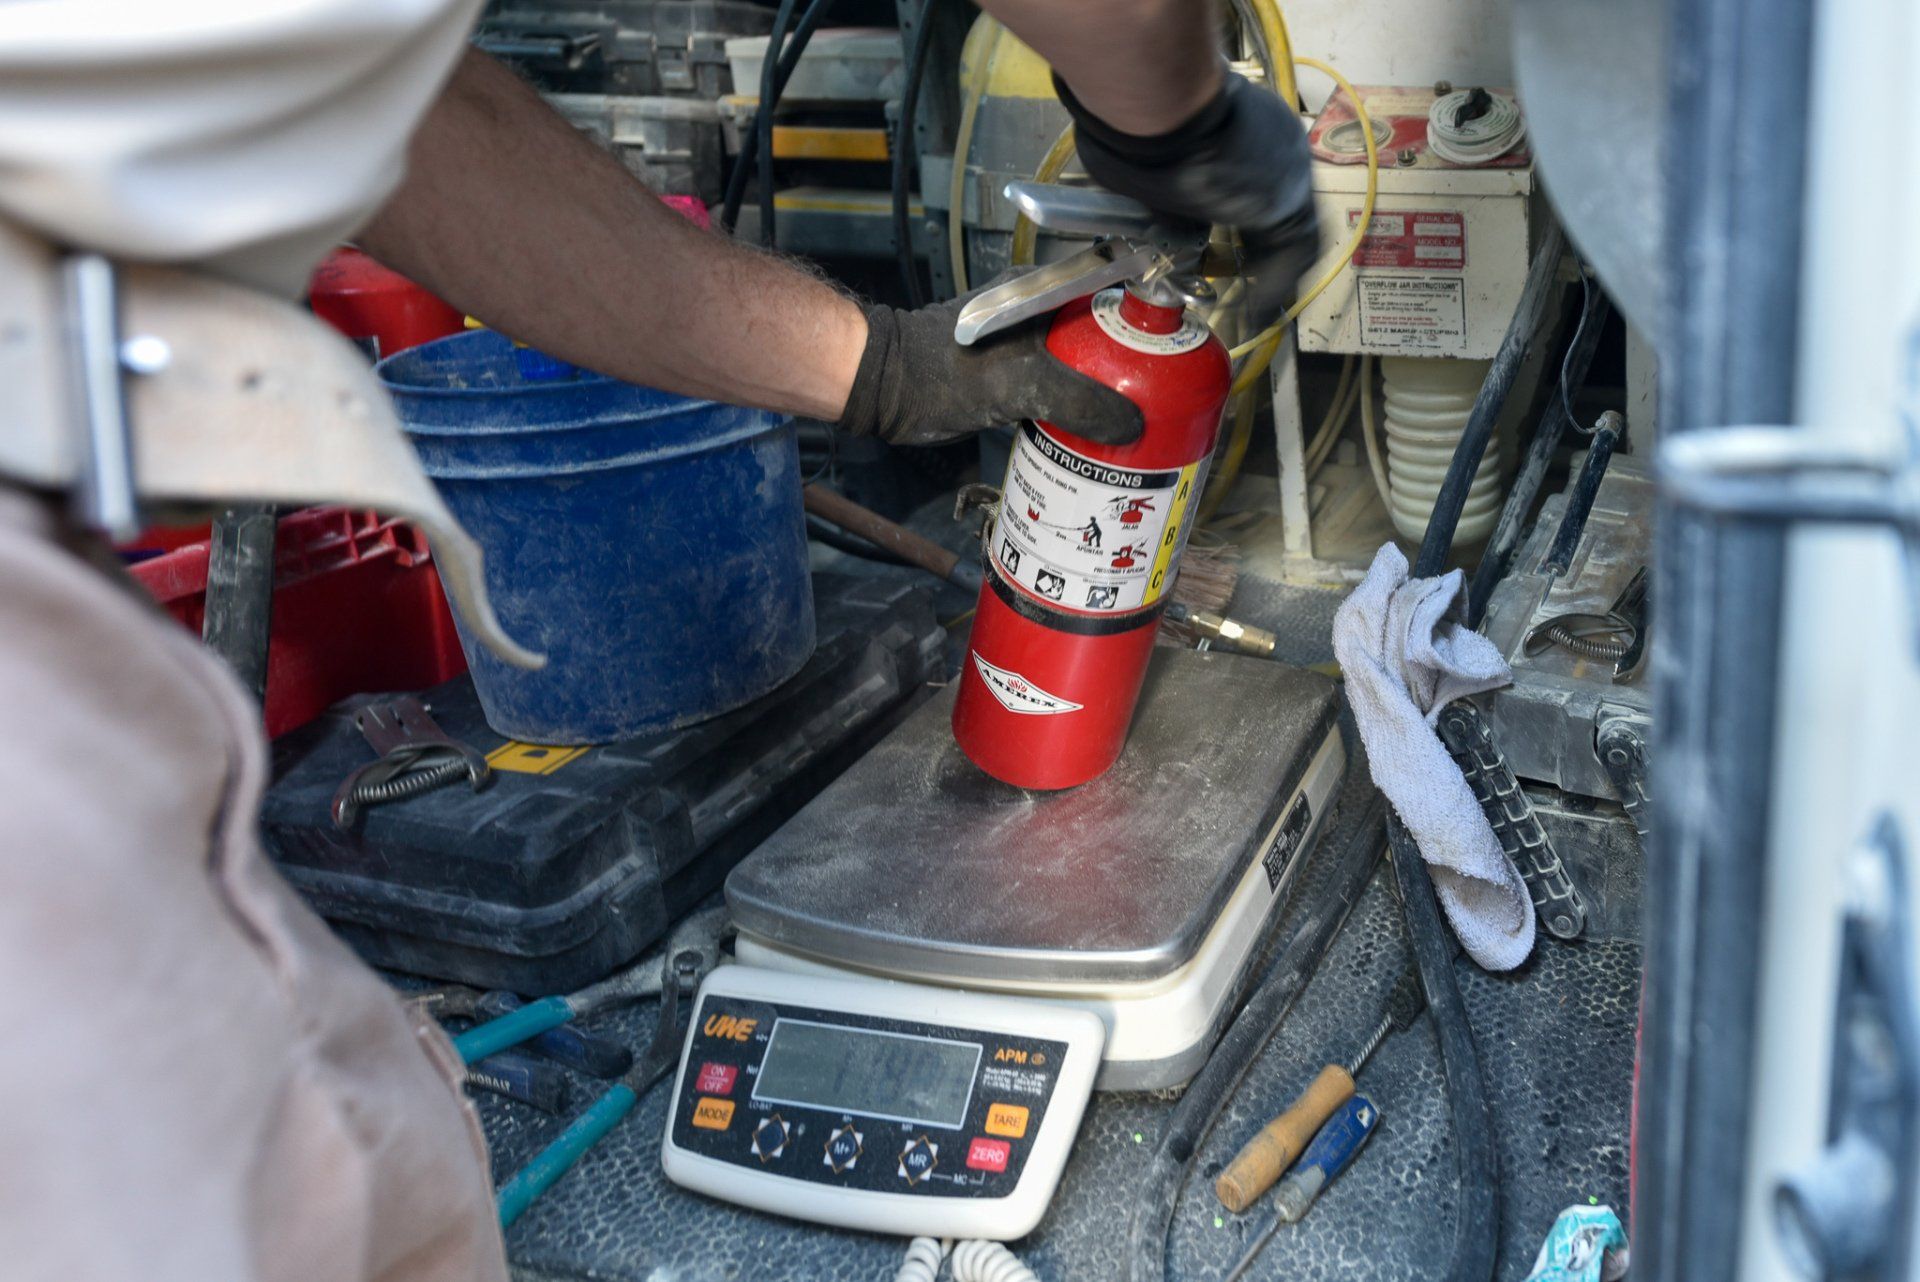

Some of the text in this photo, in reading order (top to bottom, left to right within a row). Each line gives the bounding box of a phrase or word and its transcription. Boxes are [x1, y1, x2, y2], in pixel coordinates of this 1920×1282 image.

[1399, 281, 1411, 289] JAR
[1034, 431, 1143, 488] INSTRUCTIONS
[1178, 480, 1189, 501] A
[1121, 523, 1139, 531] JALAR
[1164, 526, 1176, 546] B
[1076, 544, 1104, 556] APUNTAR
[1151, 569, 1163, 589] C
[983, 669, 1056, 708] AMEREX
[703, 1014, 758, 1042] UWE
[994, 1048, 1028, 1065] APM
[710, 1064, 726, 1077] ON
[704, 1080, 724, 1092] OFF
[698, 1107, 730, 1121] MODE
[994, 1113, 1020, 1129] TARE
[833, 1141, 850, 1155] M+
[971, 1146, 1005, 1164] ZERO
[907, 1152, 927, 1168] MR
[953, 1173, 968, 1185] MC
